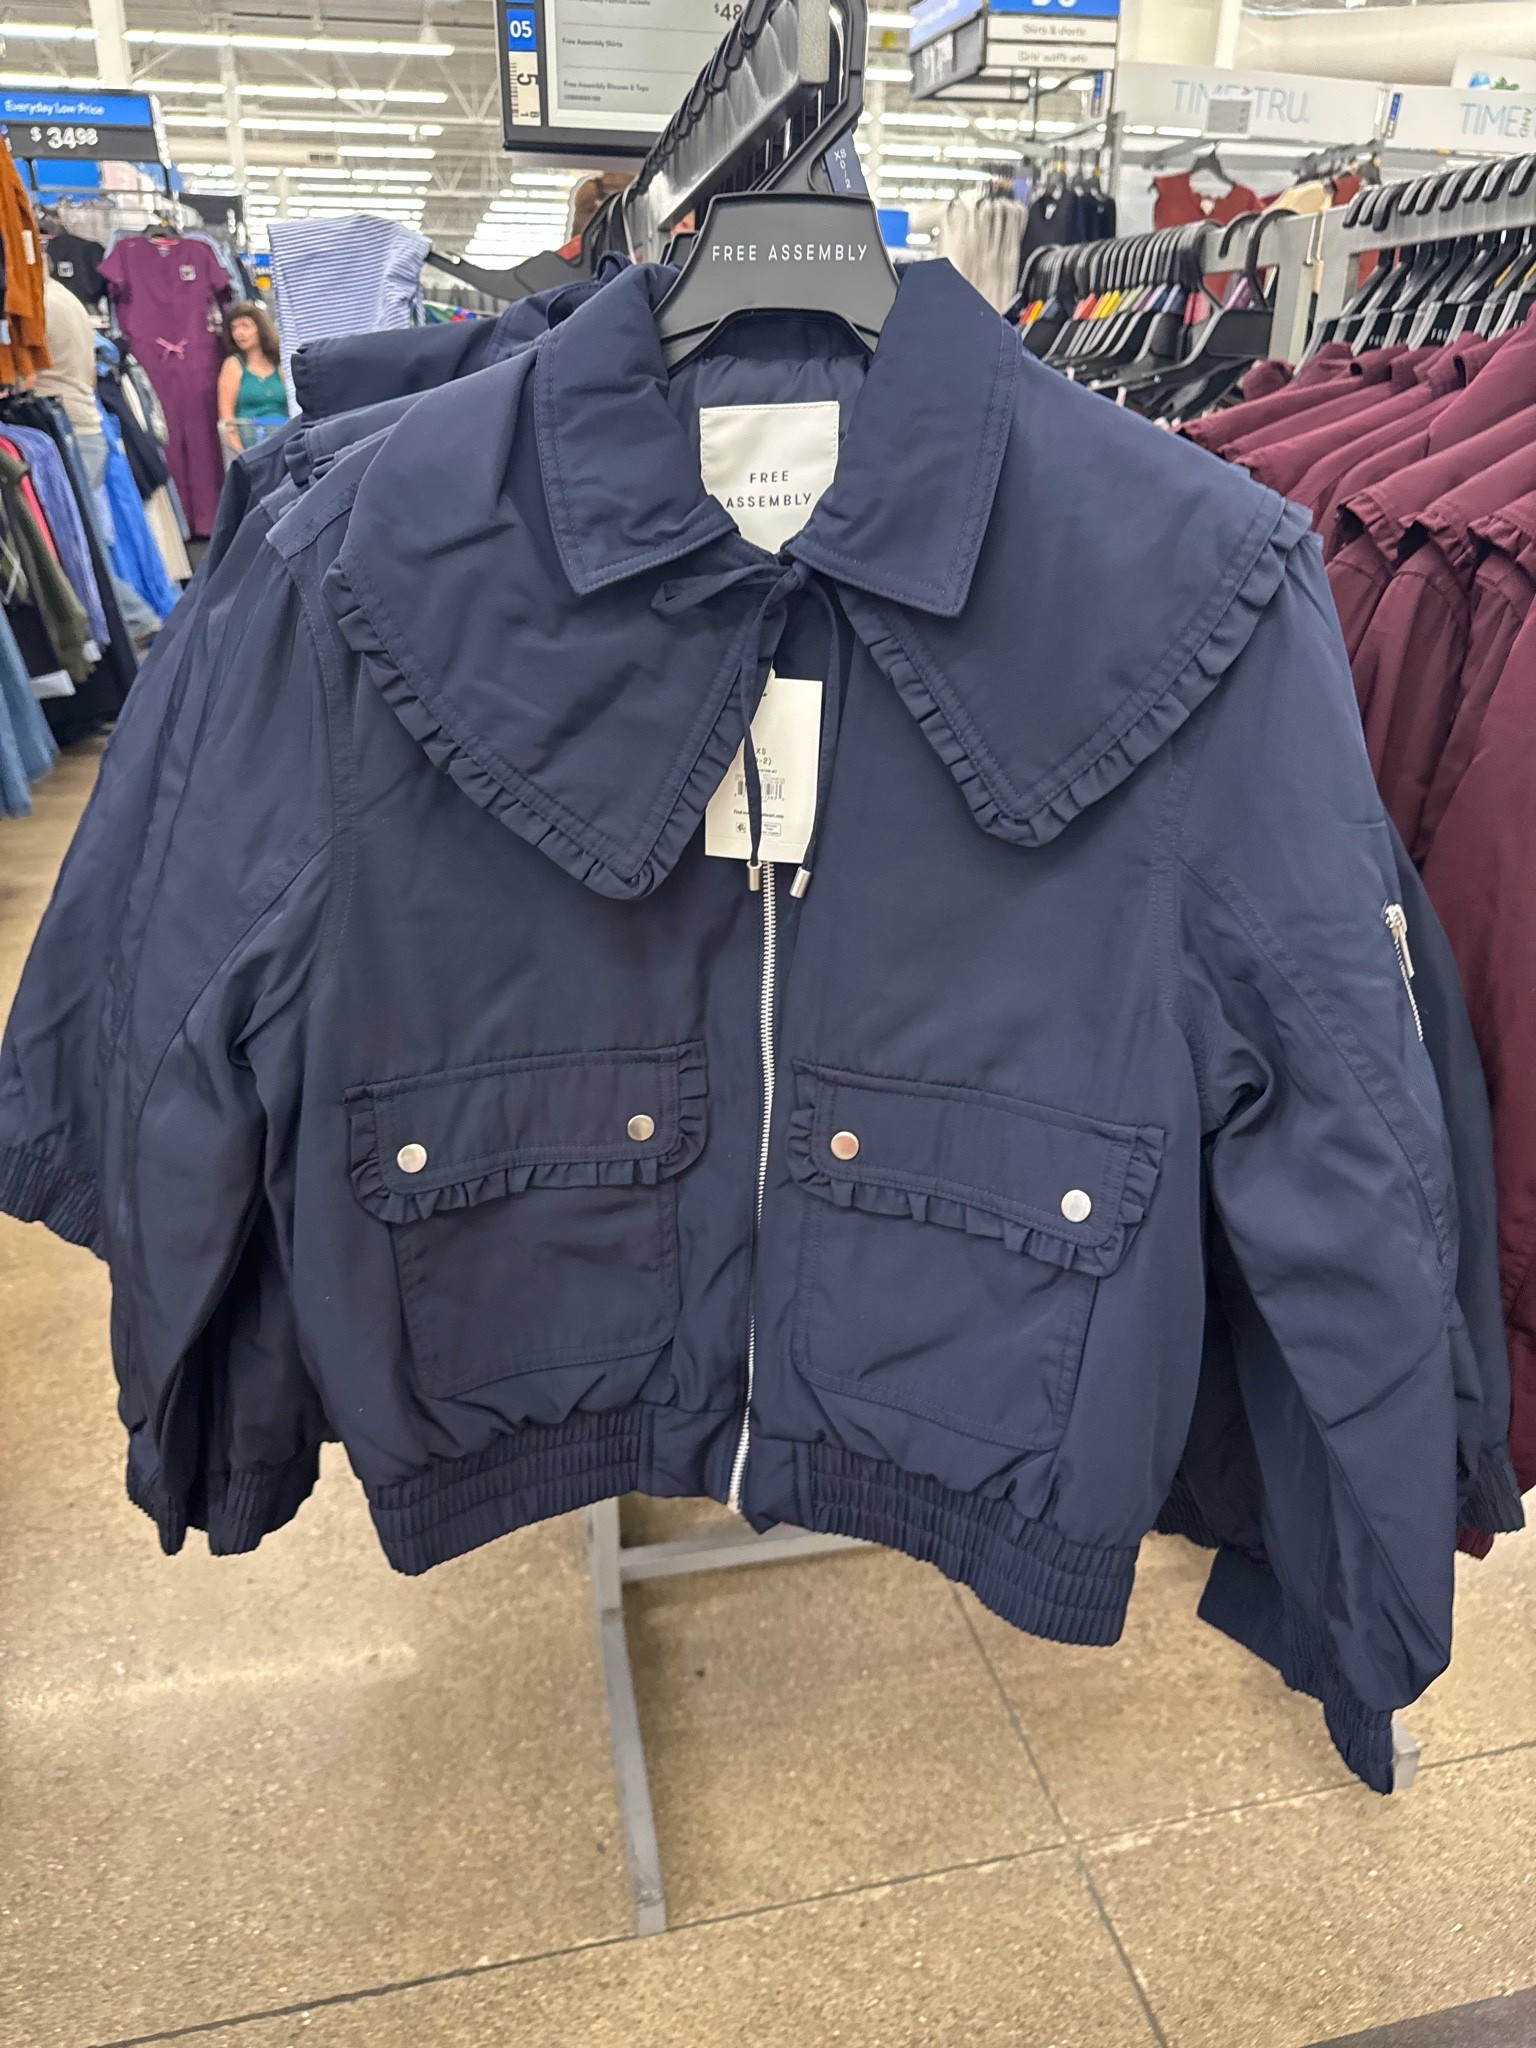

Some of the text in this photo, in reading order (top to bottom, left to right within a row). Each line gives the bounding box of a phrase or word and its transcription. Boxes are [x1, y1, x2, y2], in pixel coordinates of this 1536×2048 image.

[510, 20, 532, 38] 05
[577, 39, 604, 48] Assembly
[4, 99, 105, 116] Everyday Low Price
[1253, 85, 1310, 124] TRU
[1459, 102, 1521, 138] TIME
[712, 244, 867, 261] FREE ASSEMBLY
[749, 470, 790, 484] FREE
[726, 493, 812, 509] ASSEMBLY
[756, 747, 766, 756] XS
